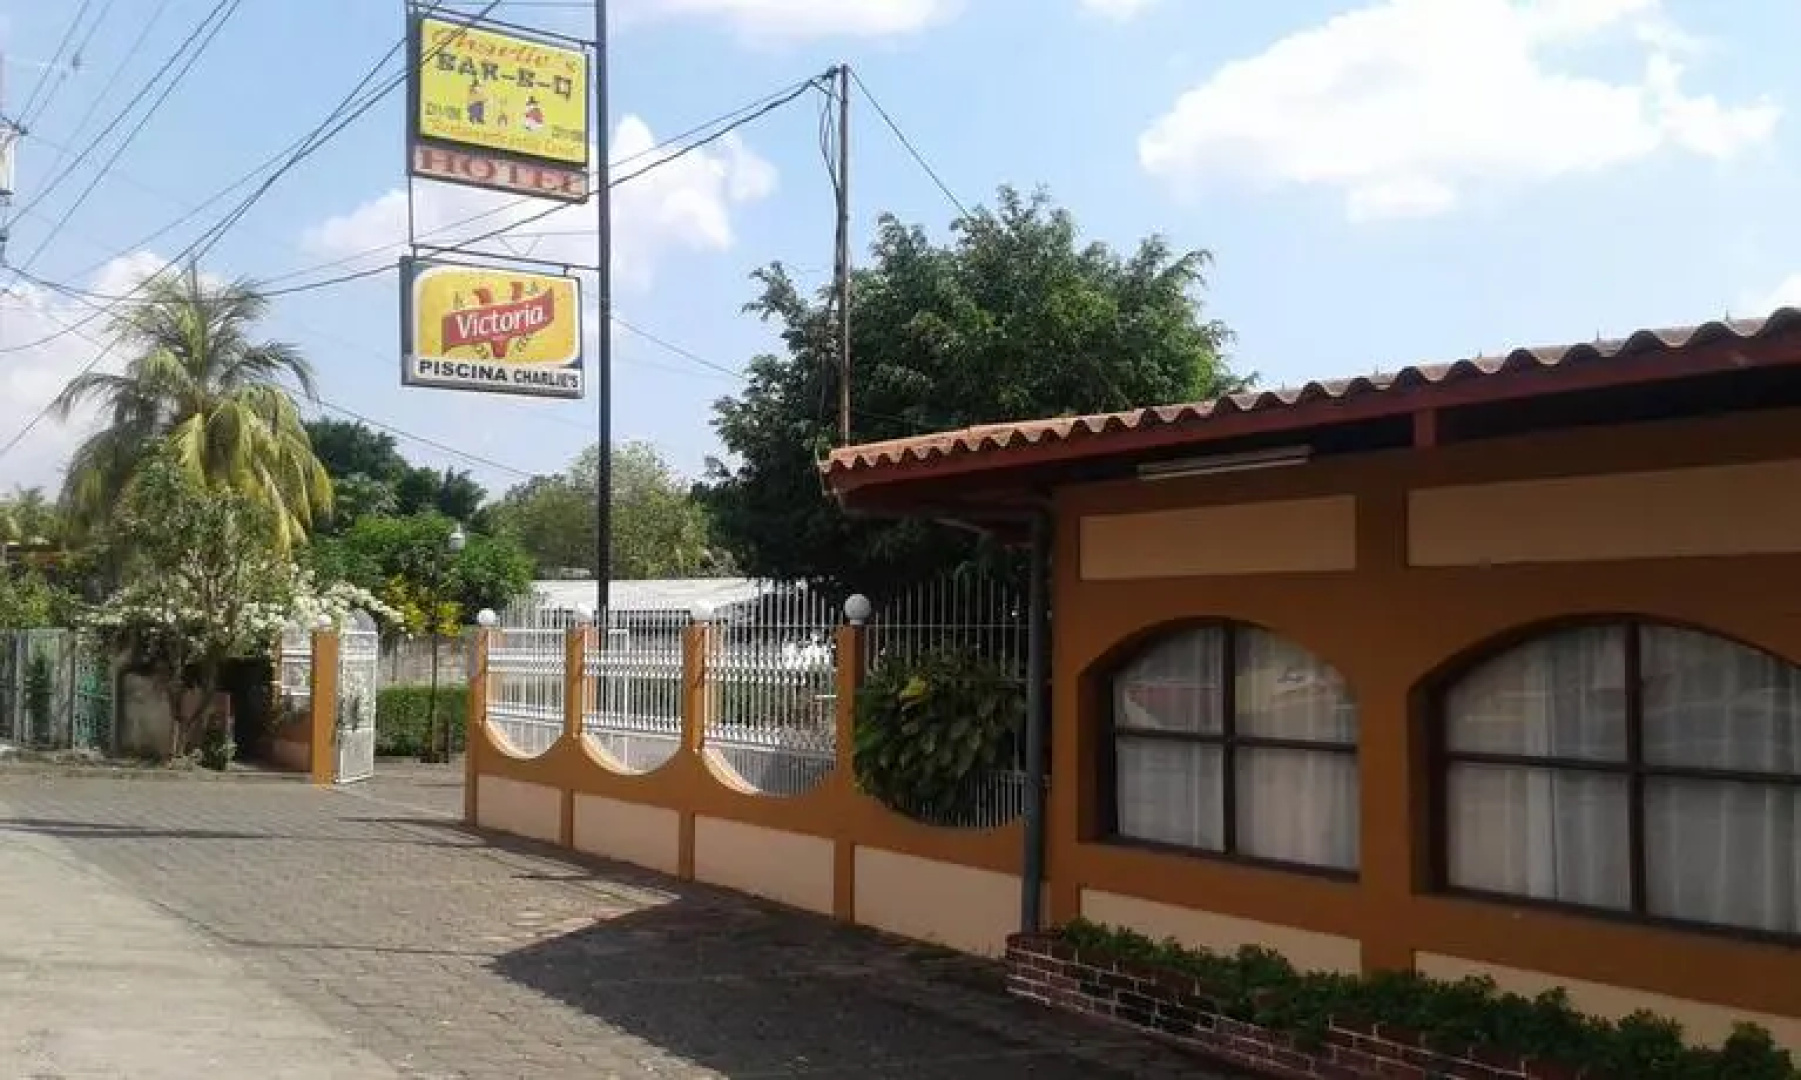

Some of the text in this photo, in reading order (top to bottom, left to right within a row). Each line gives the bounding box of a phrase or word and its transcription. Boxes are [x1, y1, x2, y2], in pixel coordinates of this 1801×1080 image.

[419, 149, 584, 195] HOTEL
[455, 303, 544, 339] Victoria
[419, 360, 579, 388] PISCINA CHARLIE'S
